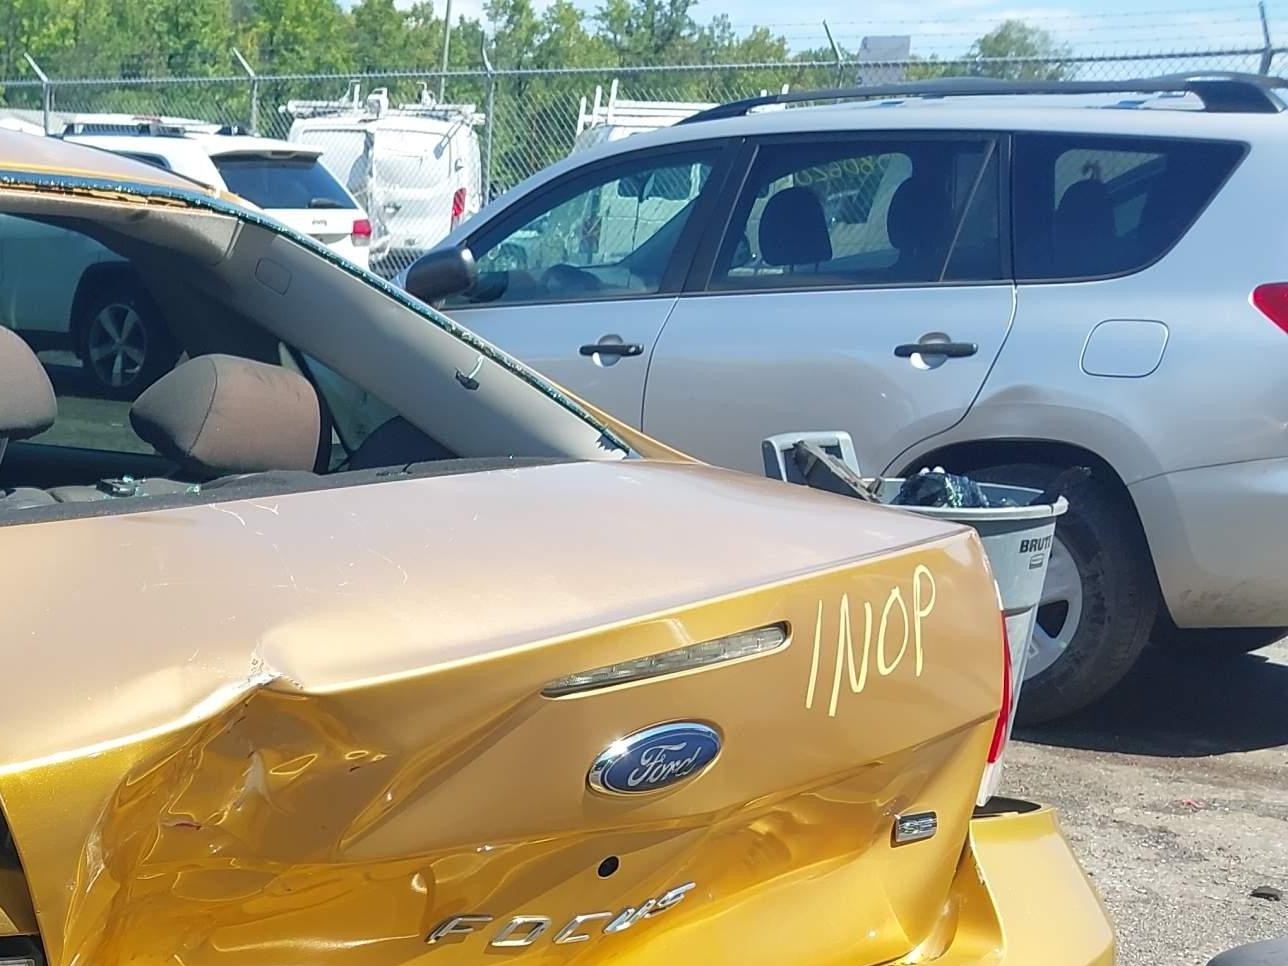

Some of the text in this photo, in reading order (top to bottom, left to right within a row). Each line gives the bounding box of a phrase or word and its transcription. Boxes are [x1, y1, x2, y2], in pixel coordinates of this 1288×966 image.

[805, 563, 936, 717] INOP
[627, 742, 701, 787] Ford
[426, 881, 697, 947] FOCUS
